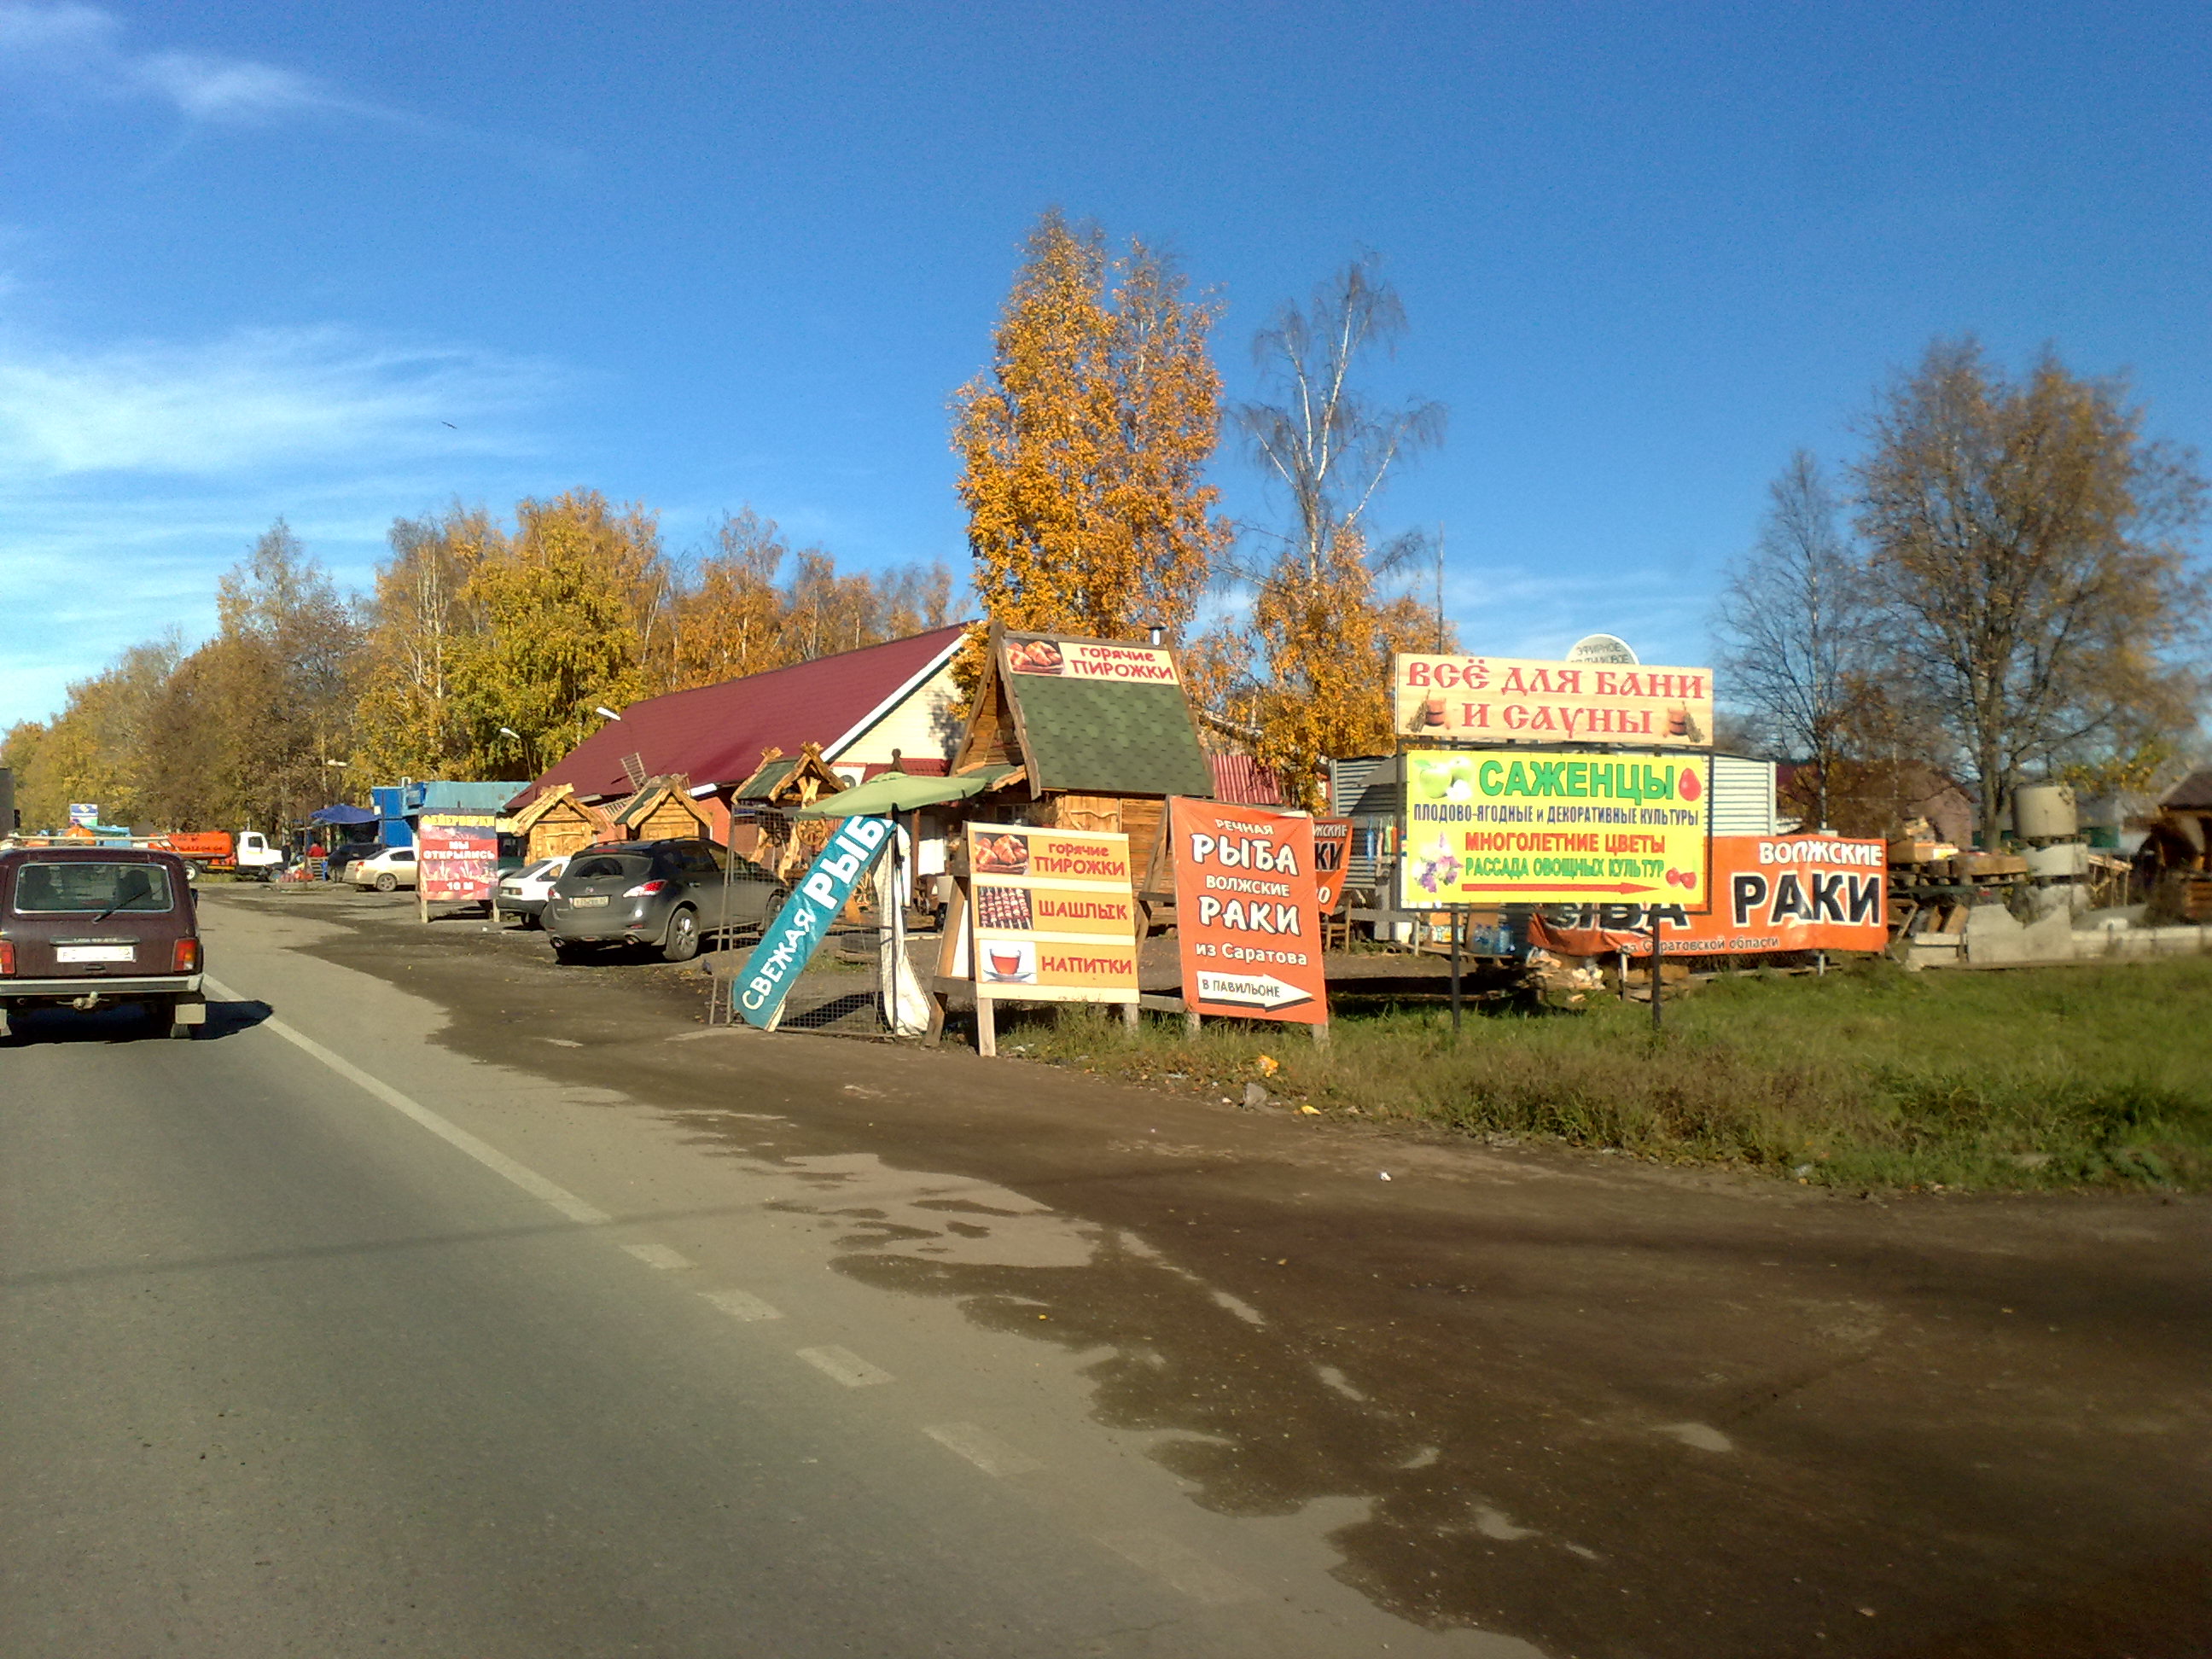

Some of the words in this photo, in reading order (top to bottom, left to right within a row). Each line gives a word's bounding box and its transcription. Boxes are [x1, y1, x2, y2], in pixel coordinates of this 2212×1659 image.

[1070, 660, 1174, 681] ПИРОЖКИ
[1406, 658, 1490, 690] ВСЁ
[1500, 667, 1582, 696] ДЛЯ
[1596, 671, 1704, 699] БАНИ
[1462, 702, 1491, 728] И
[1502, 704, 1653, 739] САУНЫ
[1479, 760, 1674, 806] САЖЕНЦЫ
[1413, 803, 1533, 825] ПЛОДОВО-ЯГОДНЫЕ
[1546, 806, 1638, 825] ДЕКОРАТИВНЫЕ
[1639, 808, 1699, 826] КУЛЬТУРЫ
[1215, 818, 1274, 835] РЕЧНАЯ
[1314, 824, 1348, 837] ЖСКИЕ
[422, 850, 496, 860] ОТКРЫЛИСЬ
[448, 841, 469, 850] МЫ
[1190, 833, 1299, 876] РЫБА
[1465, 832, 1599, 853] МНОГОЛЕТНИЕ
[1605, 835, 1666, 856] ЦВЕТЫ
[1759, 840, 1884, 867] ВОЛЖСКИЕ
[1033, 856, 1125, 876] ПИРОЖКИ
[1314, 841, 1344, 871] КИ
[1465, 858, 1530, 881] РАССАДА
[1533, 858, 1604, 879] ОВОЩНЫХ
[1608, 859, 1664, 878] КУЛЬТУР
[446, 882, 461, 890] 10
[1206, 875, 1290, 897] ВОЛЖСКИЕ
[1038, 899, 1128, 920] ШАШЛЫК
[1731, 871, 1883, 928] РАКИ
[742, 908, 815, 1010] СВЕЖАЯ
[802, 815, 894, 910] РЫБ
[1198, 895, 1301, 936] РАКИ
[1196, 943, 1217, 957] из
[1221, 942, 1307, 966] Саратова
[1642, 936, 1726, 954] Сратовской
[1729, 936, 1779, 950] области
[1041, 955, 1132, 975] НАПИТКИ
[1202, 979, 1209, 990] В
[1213, 980, 1280, 998] ПАВИЛЬОНЕ
